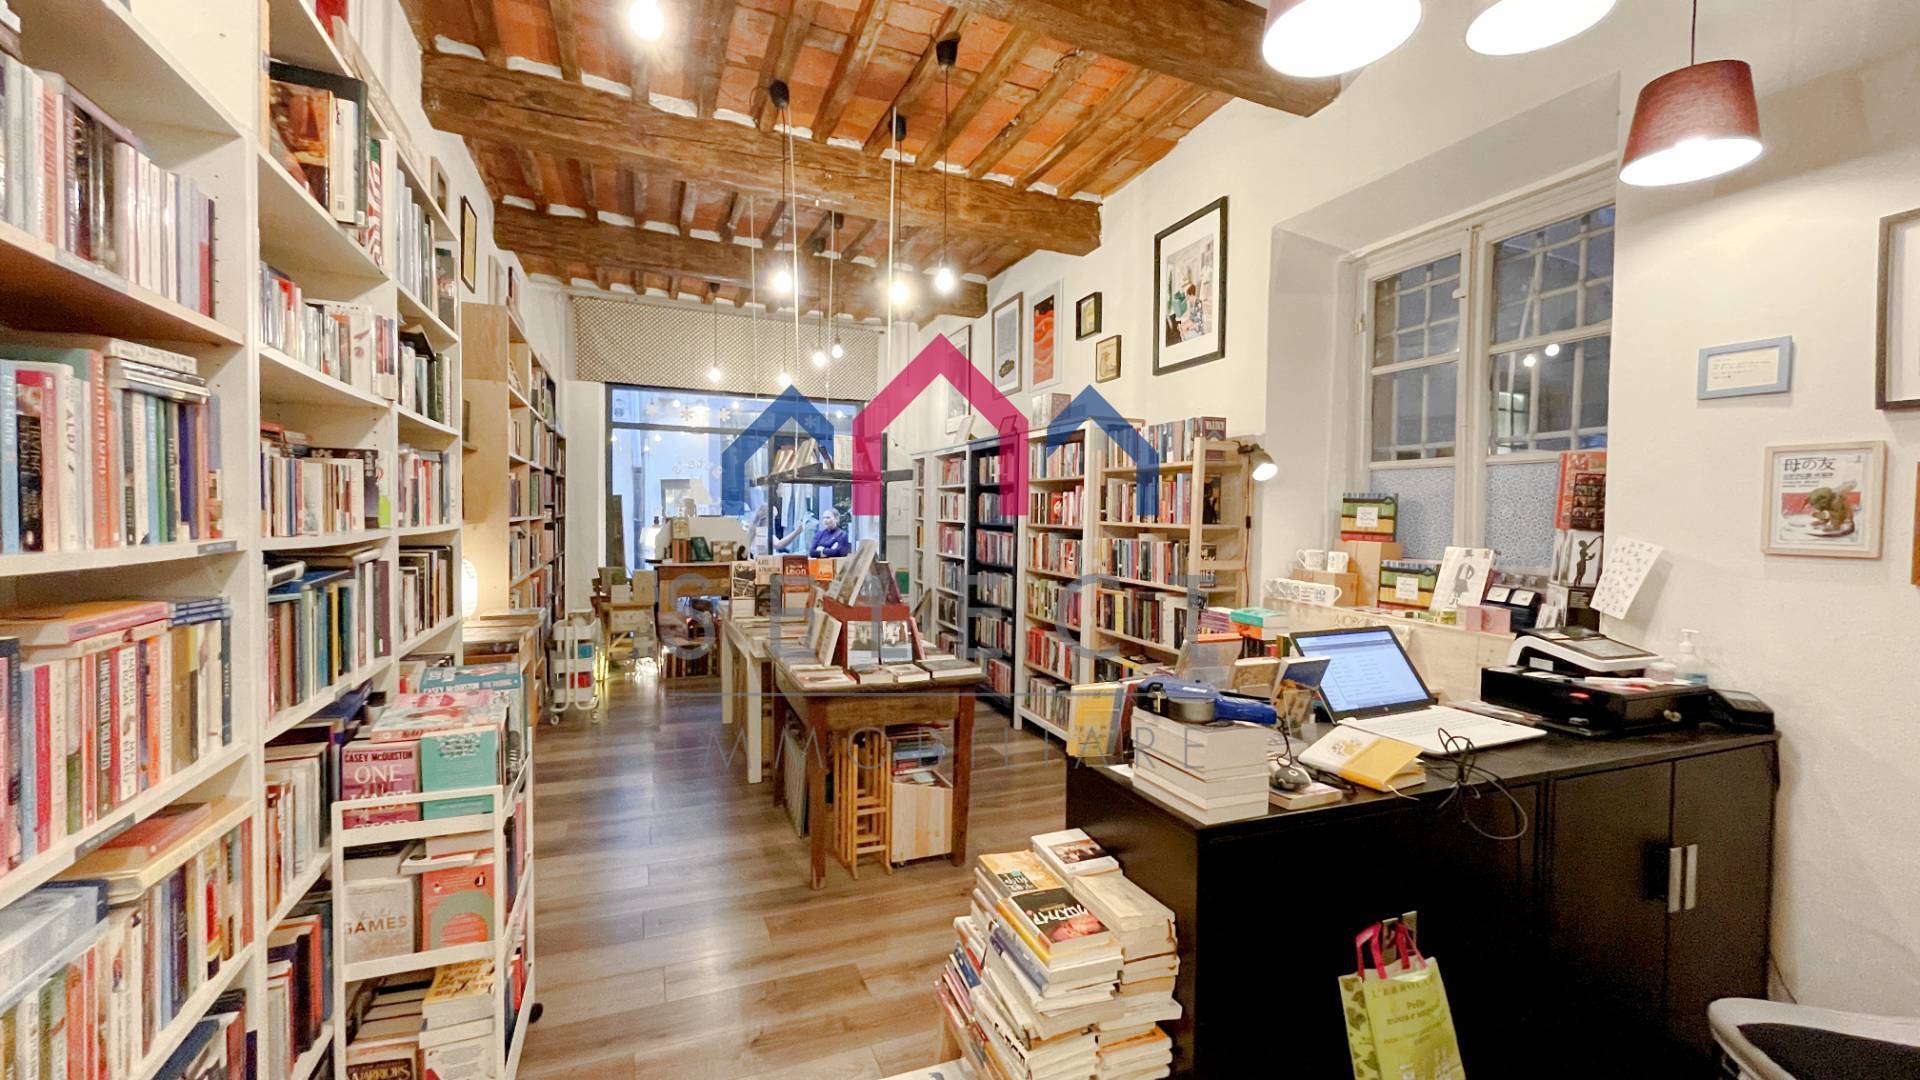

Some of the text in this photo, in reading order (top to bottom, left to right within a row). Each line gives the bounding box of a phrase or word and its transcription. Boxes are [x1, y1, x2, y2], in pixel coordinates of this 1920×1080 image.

[1783, 456, 1837, 472] 母の友
[344, 753, 369, 763] CASEY
[354, 763, 403, 784] ONE
